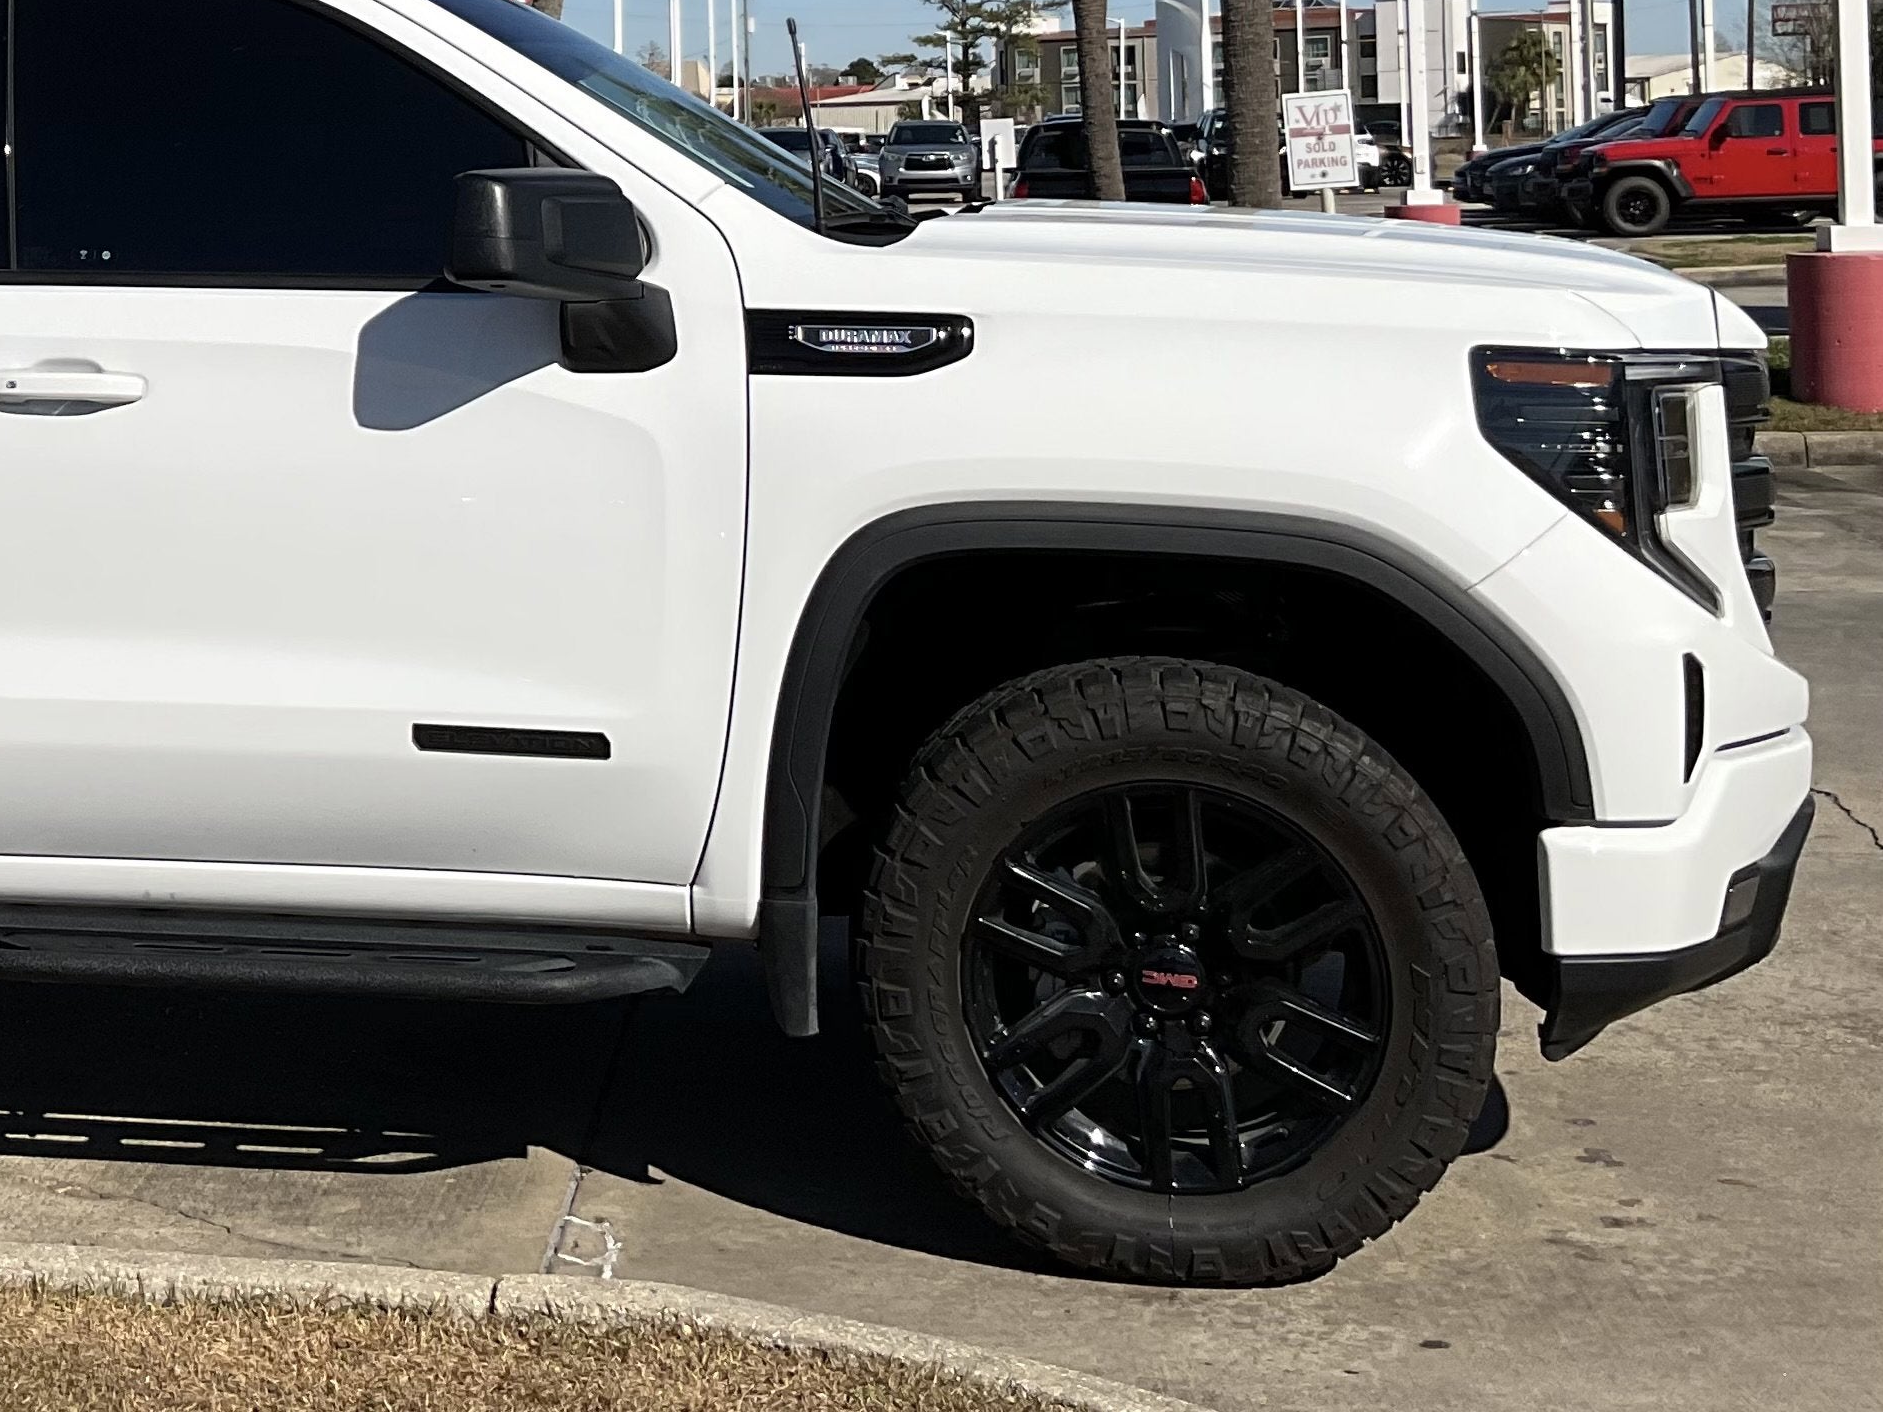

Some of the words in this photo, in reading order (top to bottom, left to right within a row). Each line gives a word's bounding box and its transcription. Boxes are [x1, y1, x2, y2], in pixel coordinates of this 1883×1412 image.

[1305, 141, 1336, 154] SOLD
[1297, 155, 1348, 169] PARKING
[819, 329, 912, 344] DURAMAX
[1142, 970, 1198, 988] GMC
